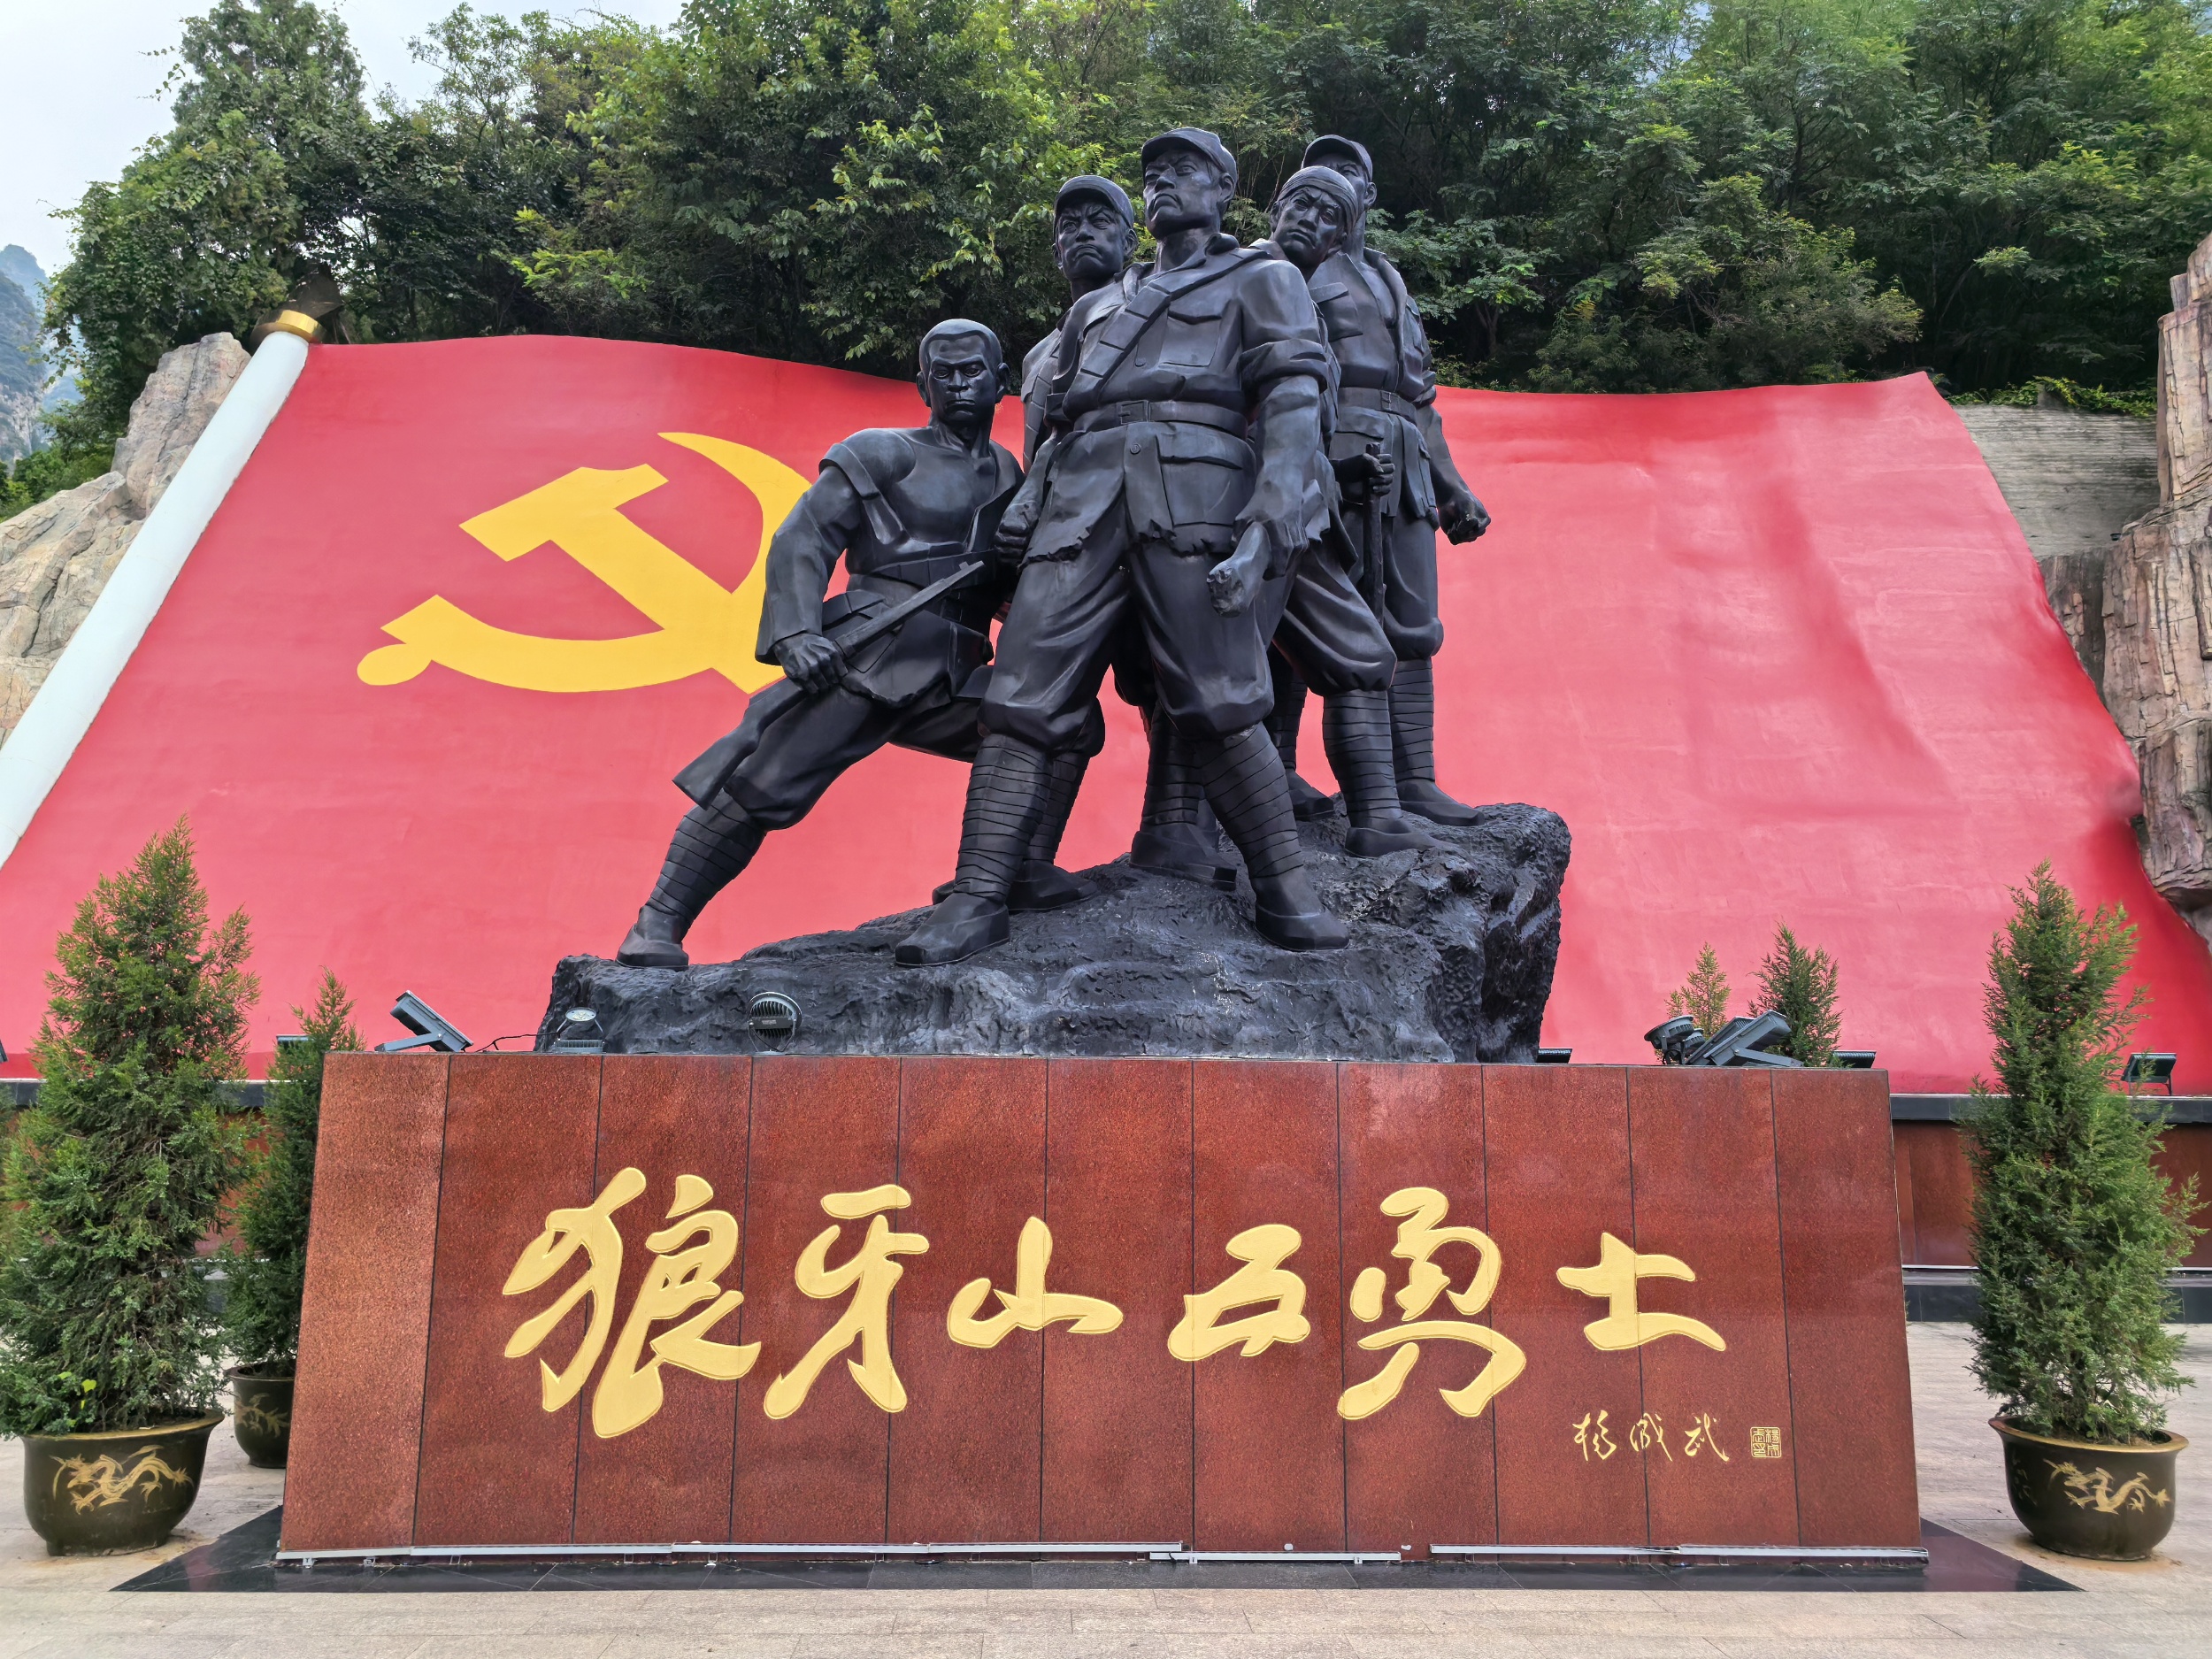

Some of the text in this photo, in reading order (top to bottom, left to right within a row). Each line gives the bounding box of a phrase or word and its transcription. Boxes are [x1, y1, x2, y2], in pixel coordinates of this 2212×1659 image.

[502, 1166, 1728, 1440] 狼牙山五勇士
